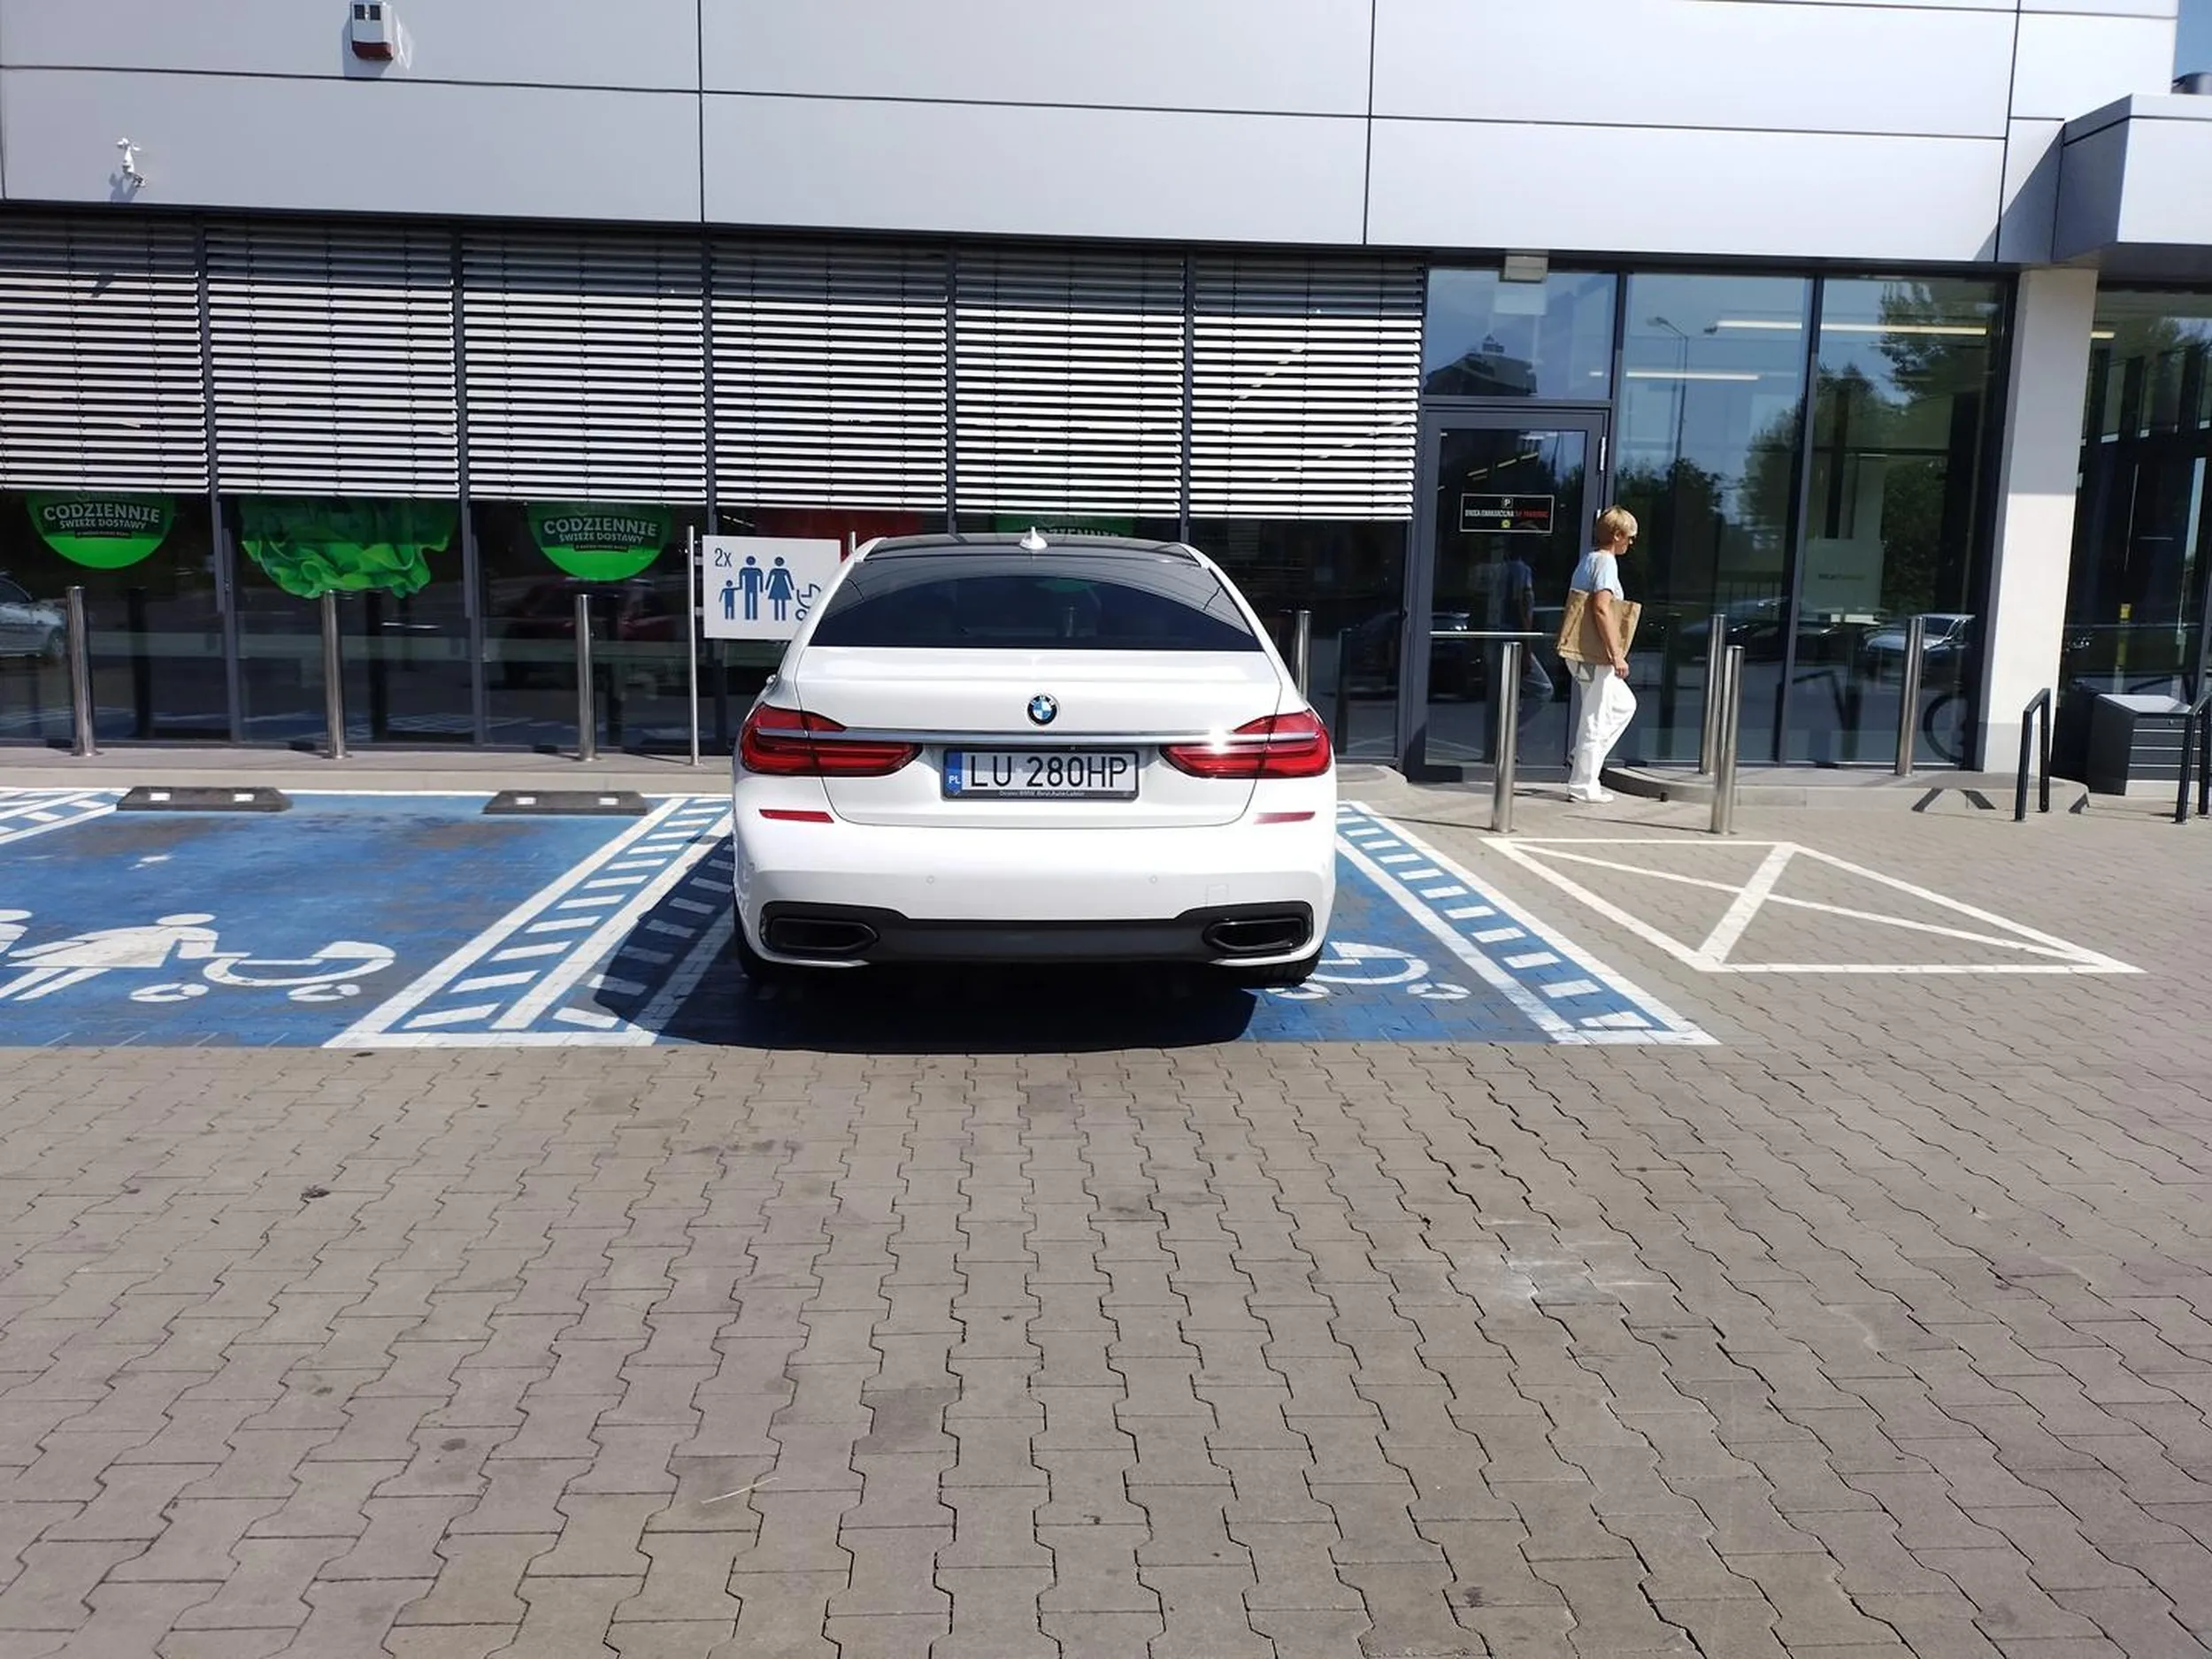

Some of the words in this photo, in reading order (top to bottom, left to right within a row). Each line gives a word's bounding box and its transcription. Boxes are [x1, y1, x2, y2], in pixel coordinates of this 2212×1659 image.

[43, 503, 160, 523] CODZIENNIE
[98, 518, 147, 529] DOSTAWY
[543, 517, 658, 536] CODZIENNIE
[596, 532, 644, 544] DOSTAWY
[714, 548, 732, 567] 2x
[949, 775, 961, 784] PL
[971, 755, 1012, 787] LU
[1026, 756, 1128, 787] 280HP
